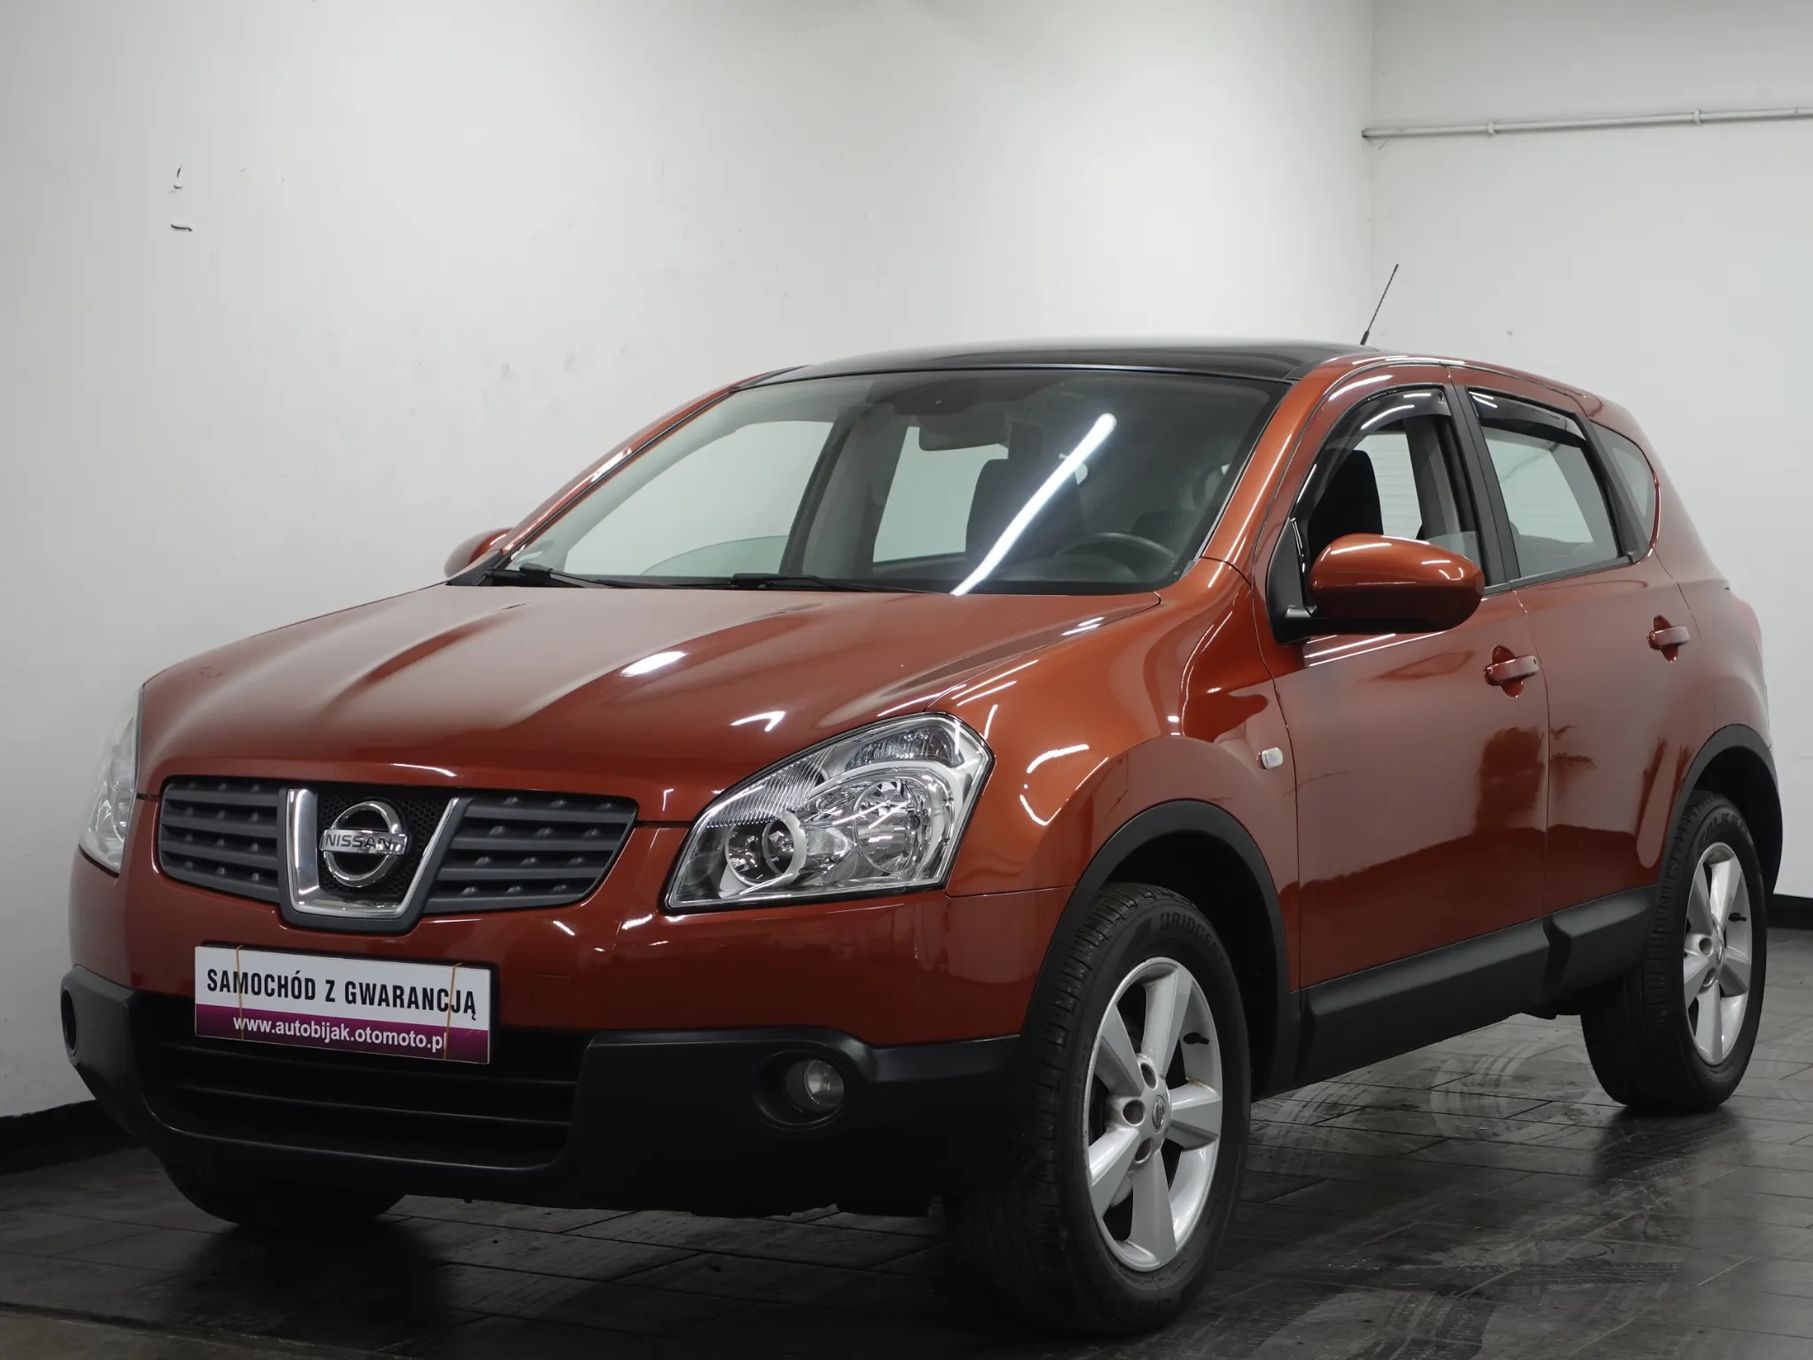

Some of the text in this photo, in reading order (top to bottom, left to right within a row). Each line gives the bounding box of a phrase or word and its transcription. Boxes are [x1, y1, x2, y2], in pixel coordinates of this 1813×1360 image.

[325, 834, 393, 850] NISSAN
[206, 968, 477, 1021] SAMOCHÓD Z GWARANCJĄ
[233, 1016, 448, 1052] www.autobijak.otomoto.pl
